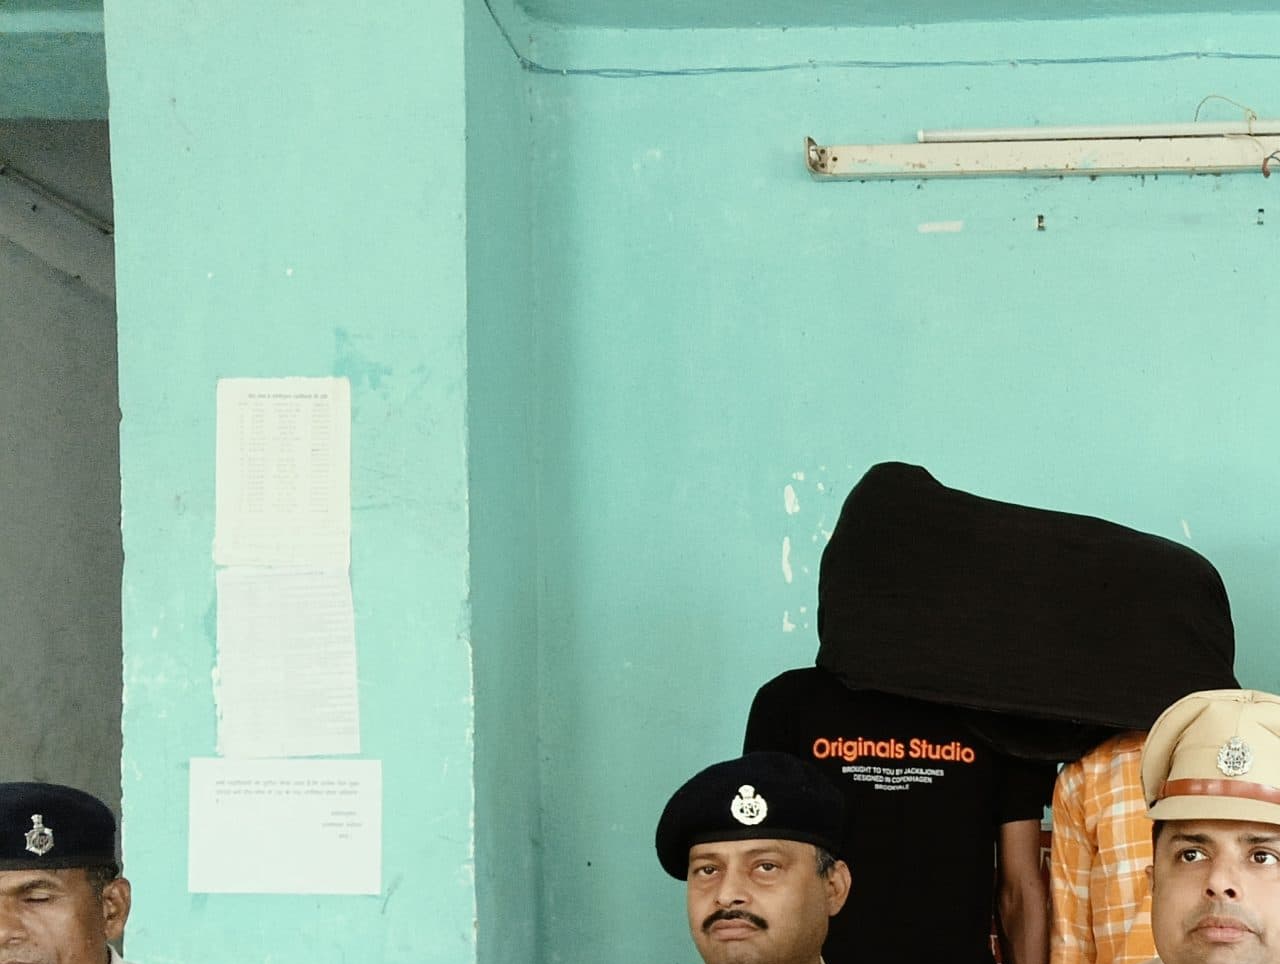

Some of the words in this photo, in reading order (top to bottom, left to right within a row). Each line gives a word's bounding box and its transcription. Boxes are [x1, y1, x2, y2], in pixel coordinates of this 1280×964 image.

[813, 737, 904, 762] Originals
[909, 738, 975, 763] Studio
[841, 765, 871, 774] BROUGHT
[872, 766, 882, 774] TO
[882, 767, 895, 775] YOU
[895, 768, 903, 776] BY
[853, 773, 884, 783] DESIGNED
[891, 775, 933, 784] COPENHAGEN
